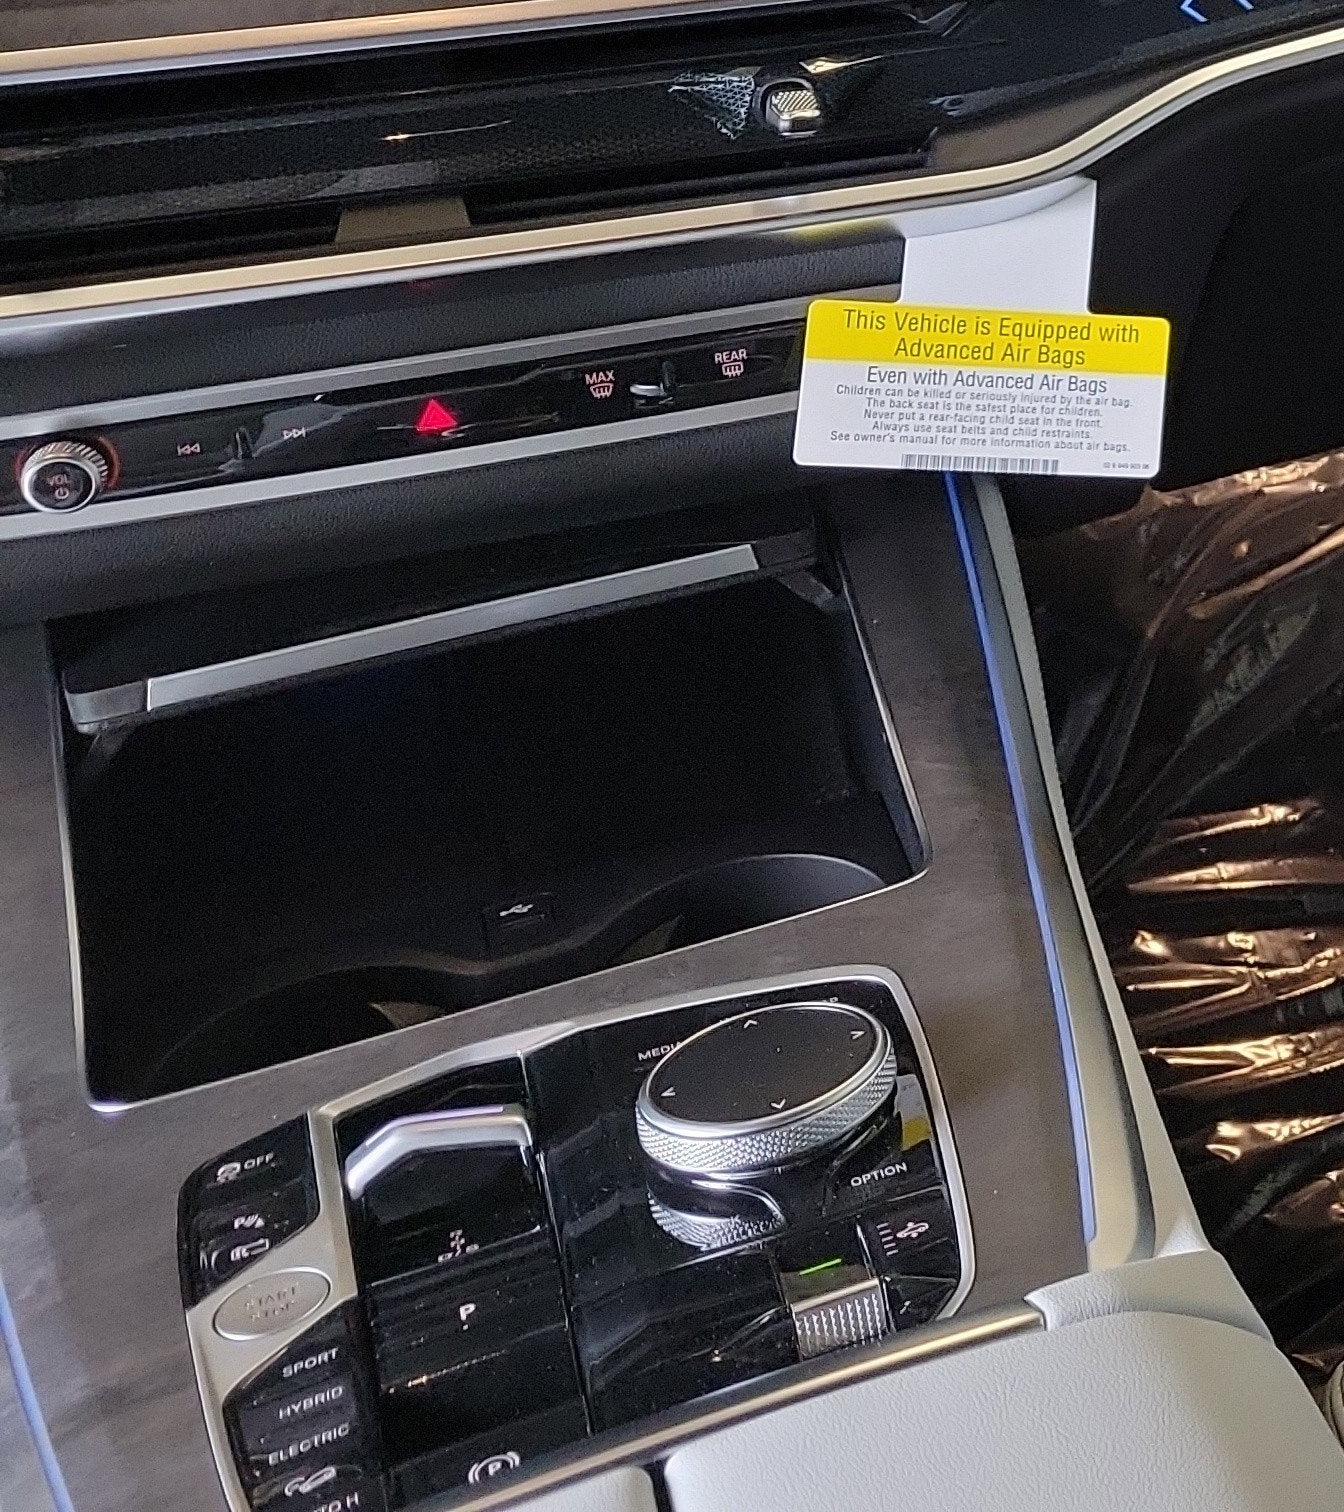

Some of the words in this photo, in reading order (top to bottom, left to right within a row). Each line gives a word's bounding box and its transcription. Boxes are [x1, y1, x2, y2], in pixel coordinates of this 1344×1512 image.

[843, 309, 886, 330] This
[895, 312, 967, 334] Vehicle
[975, 316, 991, 335] is
[999, 317, 1091, 342] Equipped
[1099, 324, 1139, 343] with
[714, 348, 748, 364] REAR
[894, 338, 994, 360] Advanced
[1001, 343, 1031, 362] Air
[1038, 345, 1085, 368] Bags
[585, 369, 615, 385] MAX
[867, 366, 907, 384] Even
[913, 369, 948, 386] with
[953, 370, 1034, 390] Advanced
[1039, 374, 1063, 391] Air
[1068, 376, 1107, 396] Bags
[836, 384, 881, 396] Children
[885, 387, 903, 397] can
[907, 388, 920, 398] be
[923, 388, 952, 399] killed
[955, 391, 967, 399] or
[970, 391, 1018, 403] seriously
[1020, 393, 1056, 404] injured
[1060, 395, 1073, 406] by
[1076, 396, 1091, 405] the
[1095, 396, 1109, 406] air
[1112, 397, 1132, 408] bag.
[866, 397, 885, 408] The
[889, 398, 914, 409] back
[917, 400, 940, 410] seat
[942, 400, 952, 410] is
[955, 401, 972, 411] the
[975, 403, 1007, 413] safest
[1010, 404, 1037, 414] place
[1041, 405, 1055, 415] for
[1058, 406, 1102, 416] children.
[864, 409, 895, 419] Never
[898, 411, 916, 421] put
[919, 412, 925, 421] a
[928, 413, 985, 425] rear-facing
[989, 415, 1014, 424] child
[1018, 416, 1039, 426] seat
[1043, 417, 1053, 426] in
[1056, 418, 1071, 427] the
[872, 421, 910, 433] Always
[913, 424, 931, 433] use
[936, 424, 957, 434] seat
[961, 425, 986, 435] belts
[989, 427, 1008, 436] and
[1012, 427, 1037, 437] child
[830, 430, 850, 441] See
[854, 433, 895, 443] owner's
[899, 434, 938, 445] manual
[941, 435, 956, 445] for
[960, 437, 986, 446] more
[990, 438, 1051, 448] information
[1054, 440, 1083, 450] about
[1087, 442, 1100, 451] air
[1103, 442, 1130, 453] bags.
[47, 474, 68, 486] VOL
[244, 1152, 274, 1170] OFF
[850, 1162, 908, 1187] OPTION
[459, 1303, 477, 1321] P
[283, 1347, 338, 1378] SPORT
[279, 1386, 343, 1420] HYBRID
[268, 1423, 350, 1466] ELECTRIC
[346, 1492, 359, 1509] H
